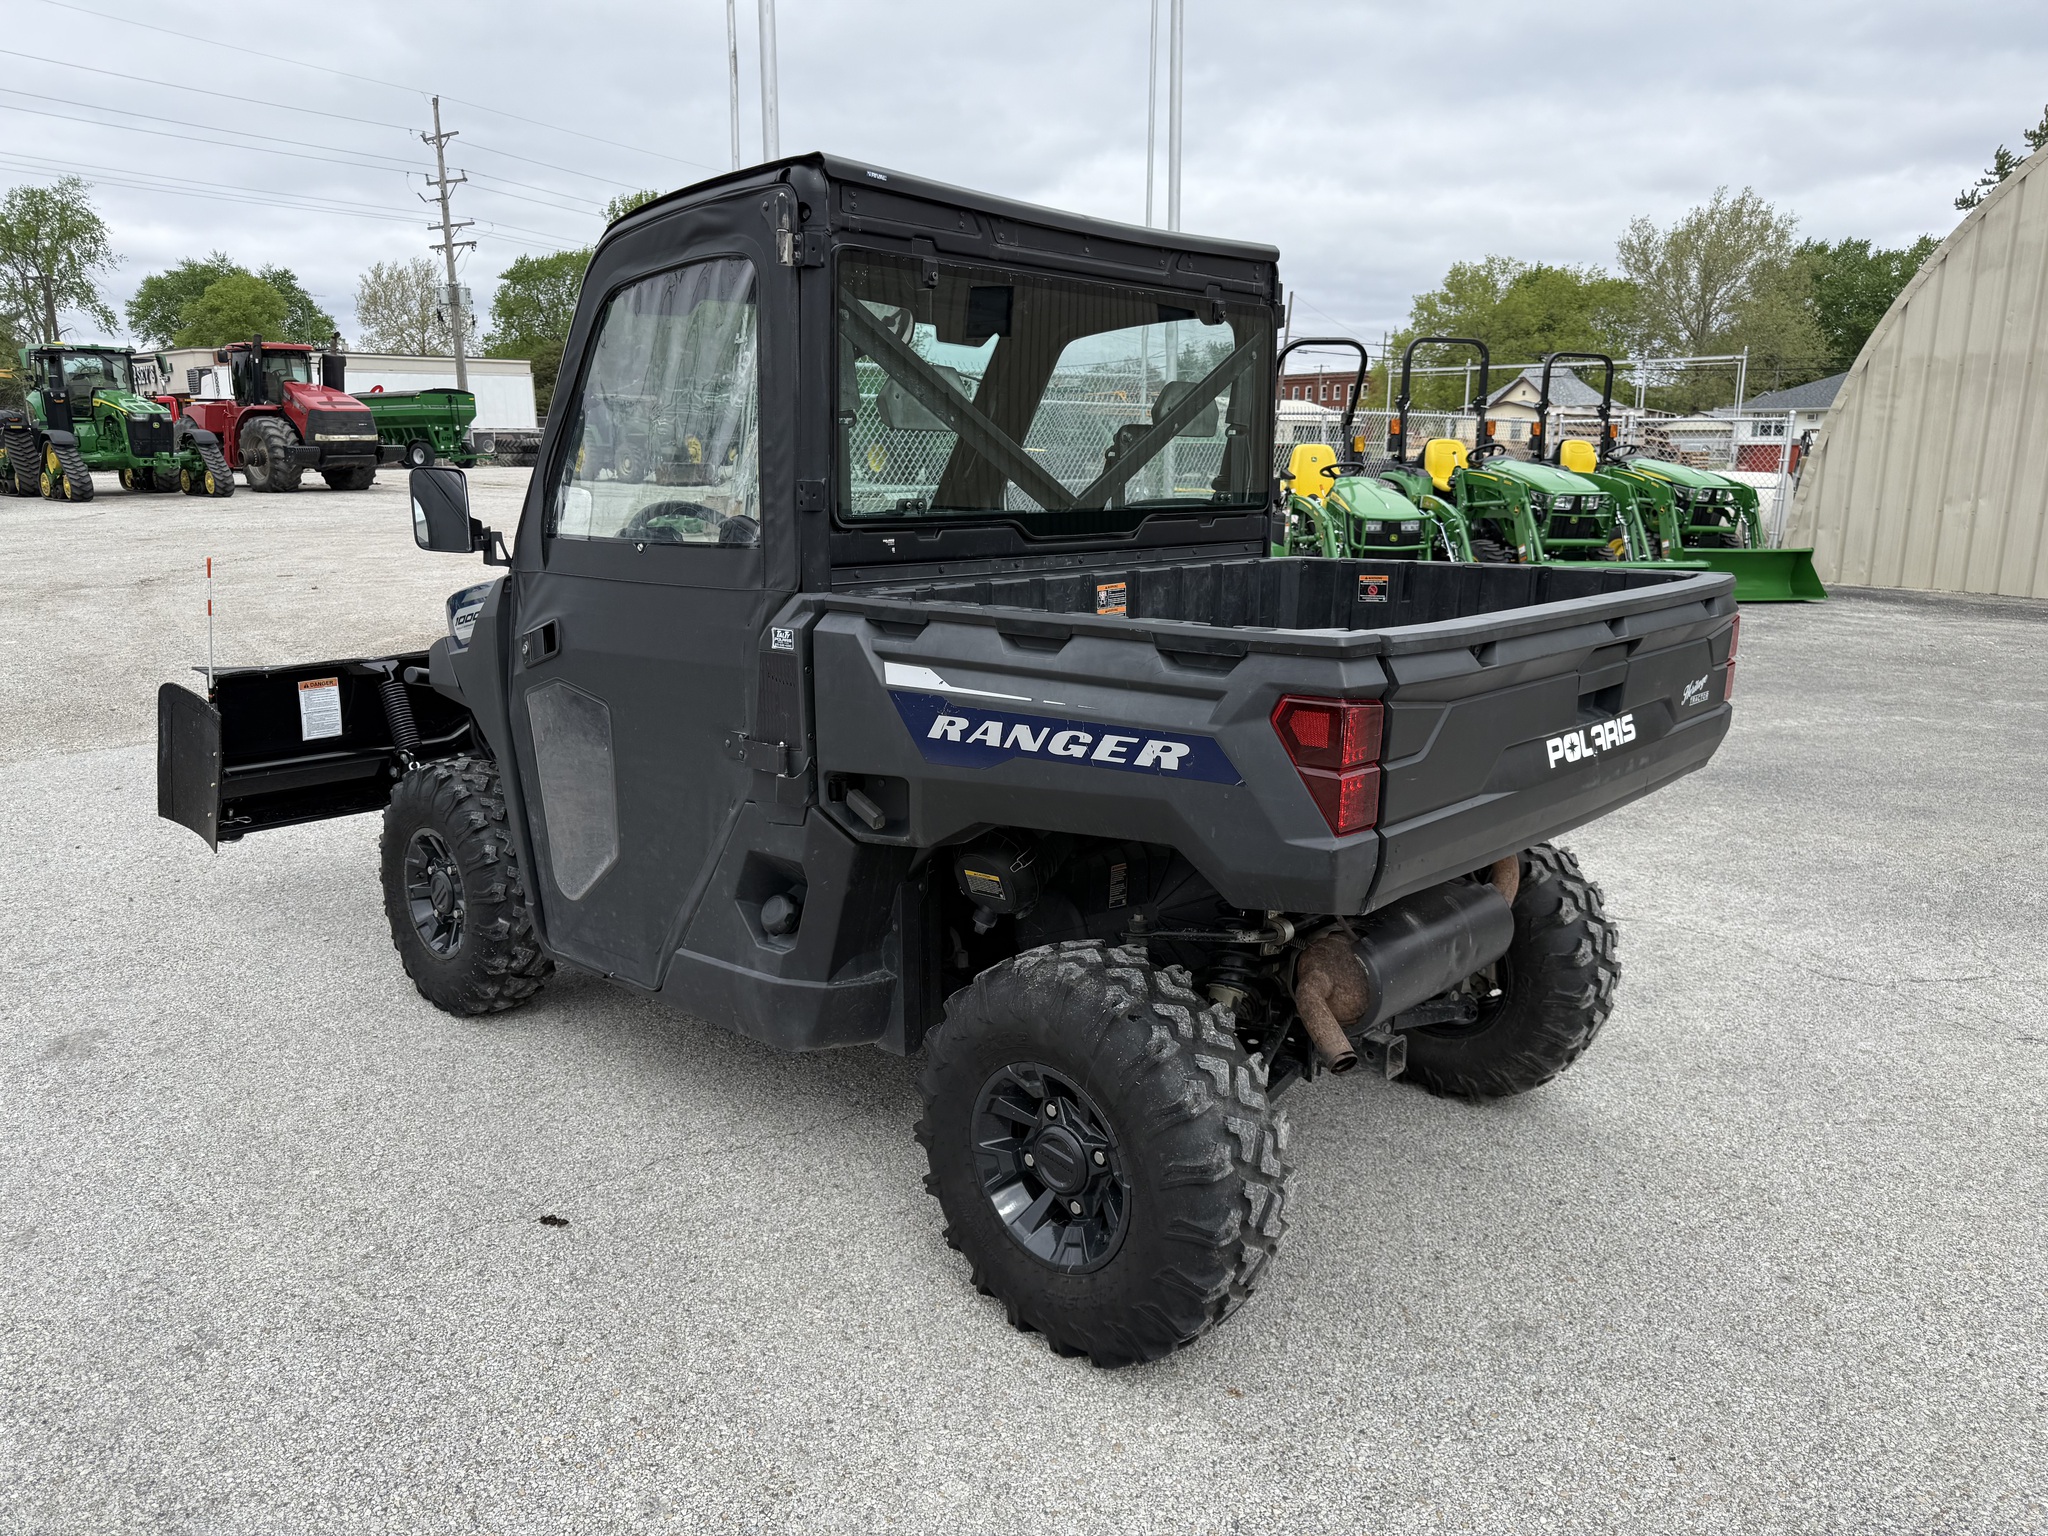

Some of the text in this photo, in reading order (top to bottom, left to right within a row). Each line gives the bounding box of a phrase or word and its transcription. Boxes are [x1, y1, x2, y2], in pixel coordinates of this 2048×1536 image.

[310, 680, 334, 688] DANGER
[926, 714, 1191, 771] RANGER
[1546, 713, 1637, 769] POLARIS
